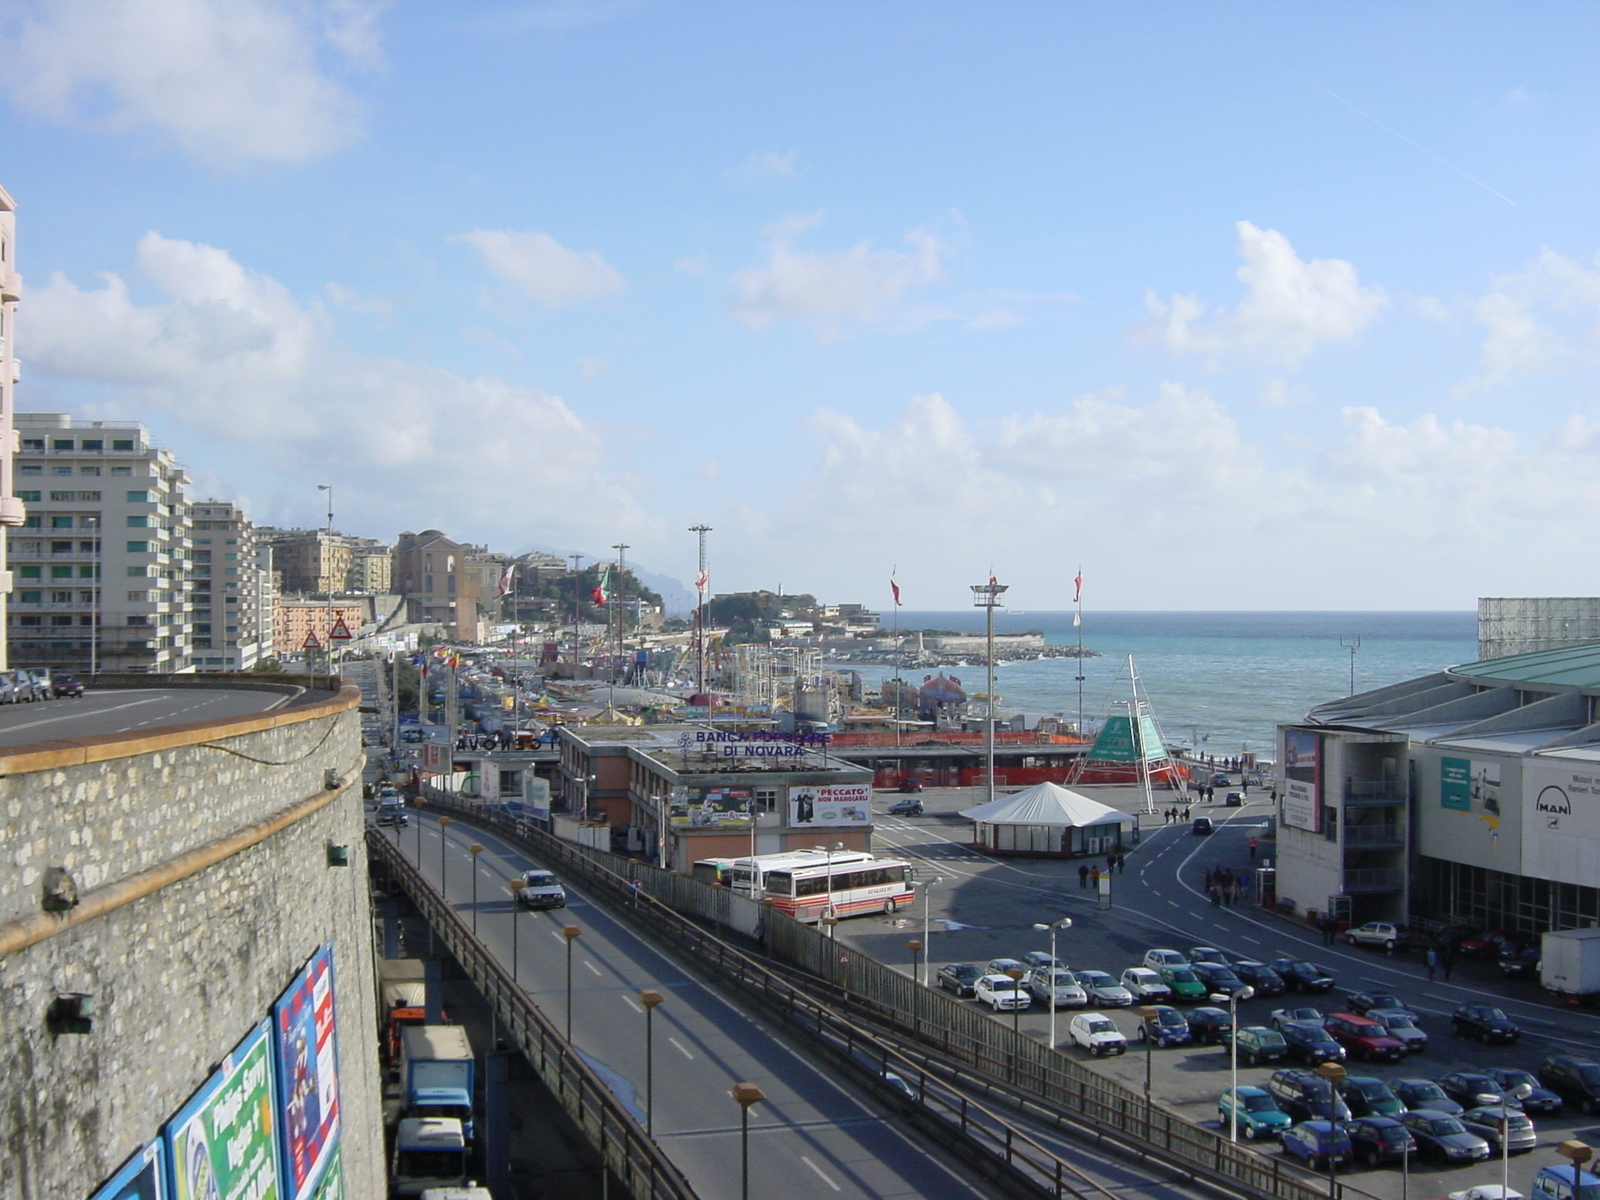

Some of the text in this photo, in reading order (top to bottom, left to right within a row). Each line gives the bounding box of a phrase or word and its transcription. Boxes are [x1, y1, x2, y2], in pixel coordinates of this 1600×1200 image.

[696, 732, 748, 742] BANCA
[723, 746, 805, 757] DI NOVARA
[1539, 803, 1568, 815] MAN
